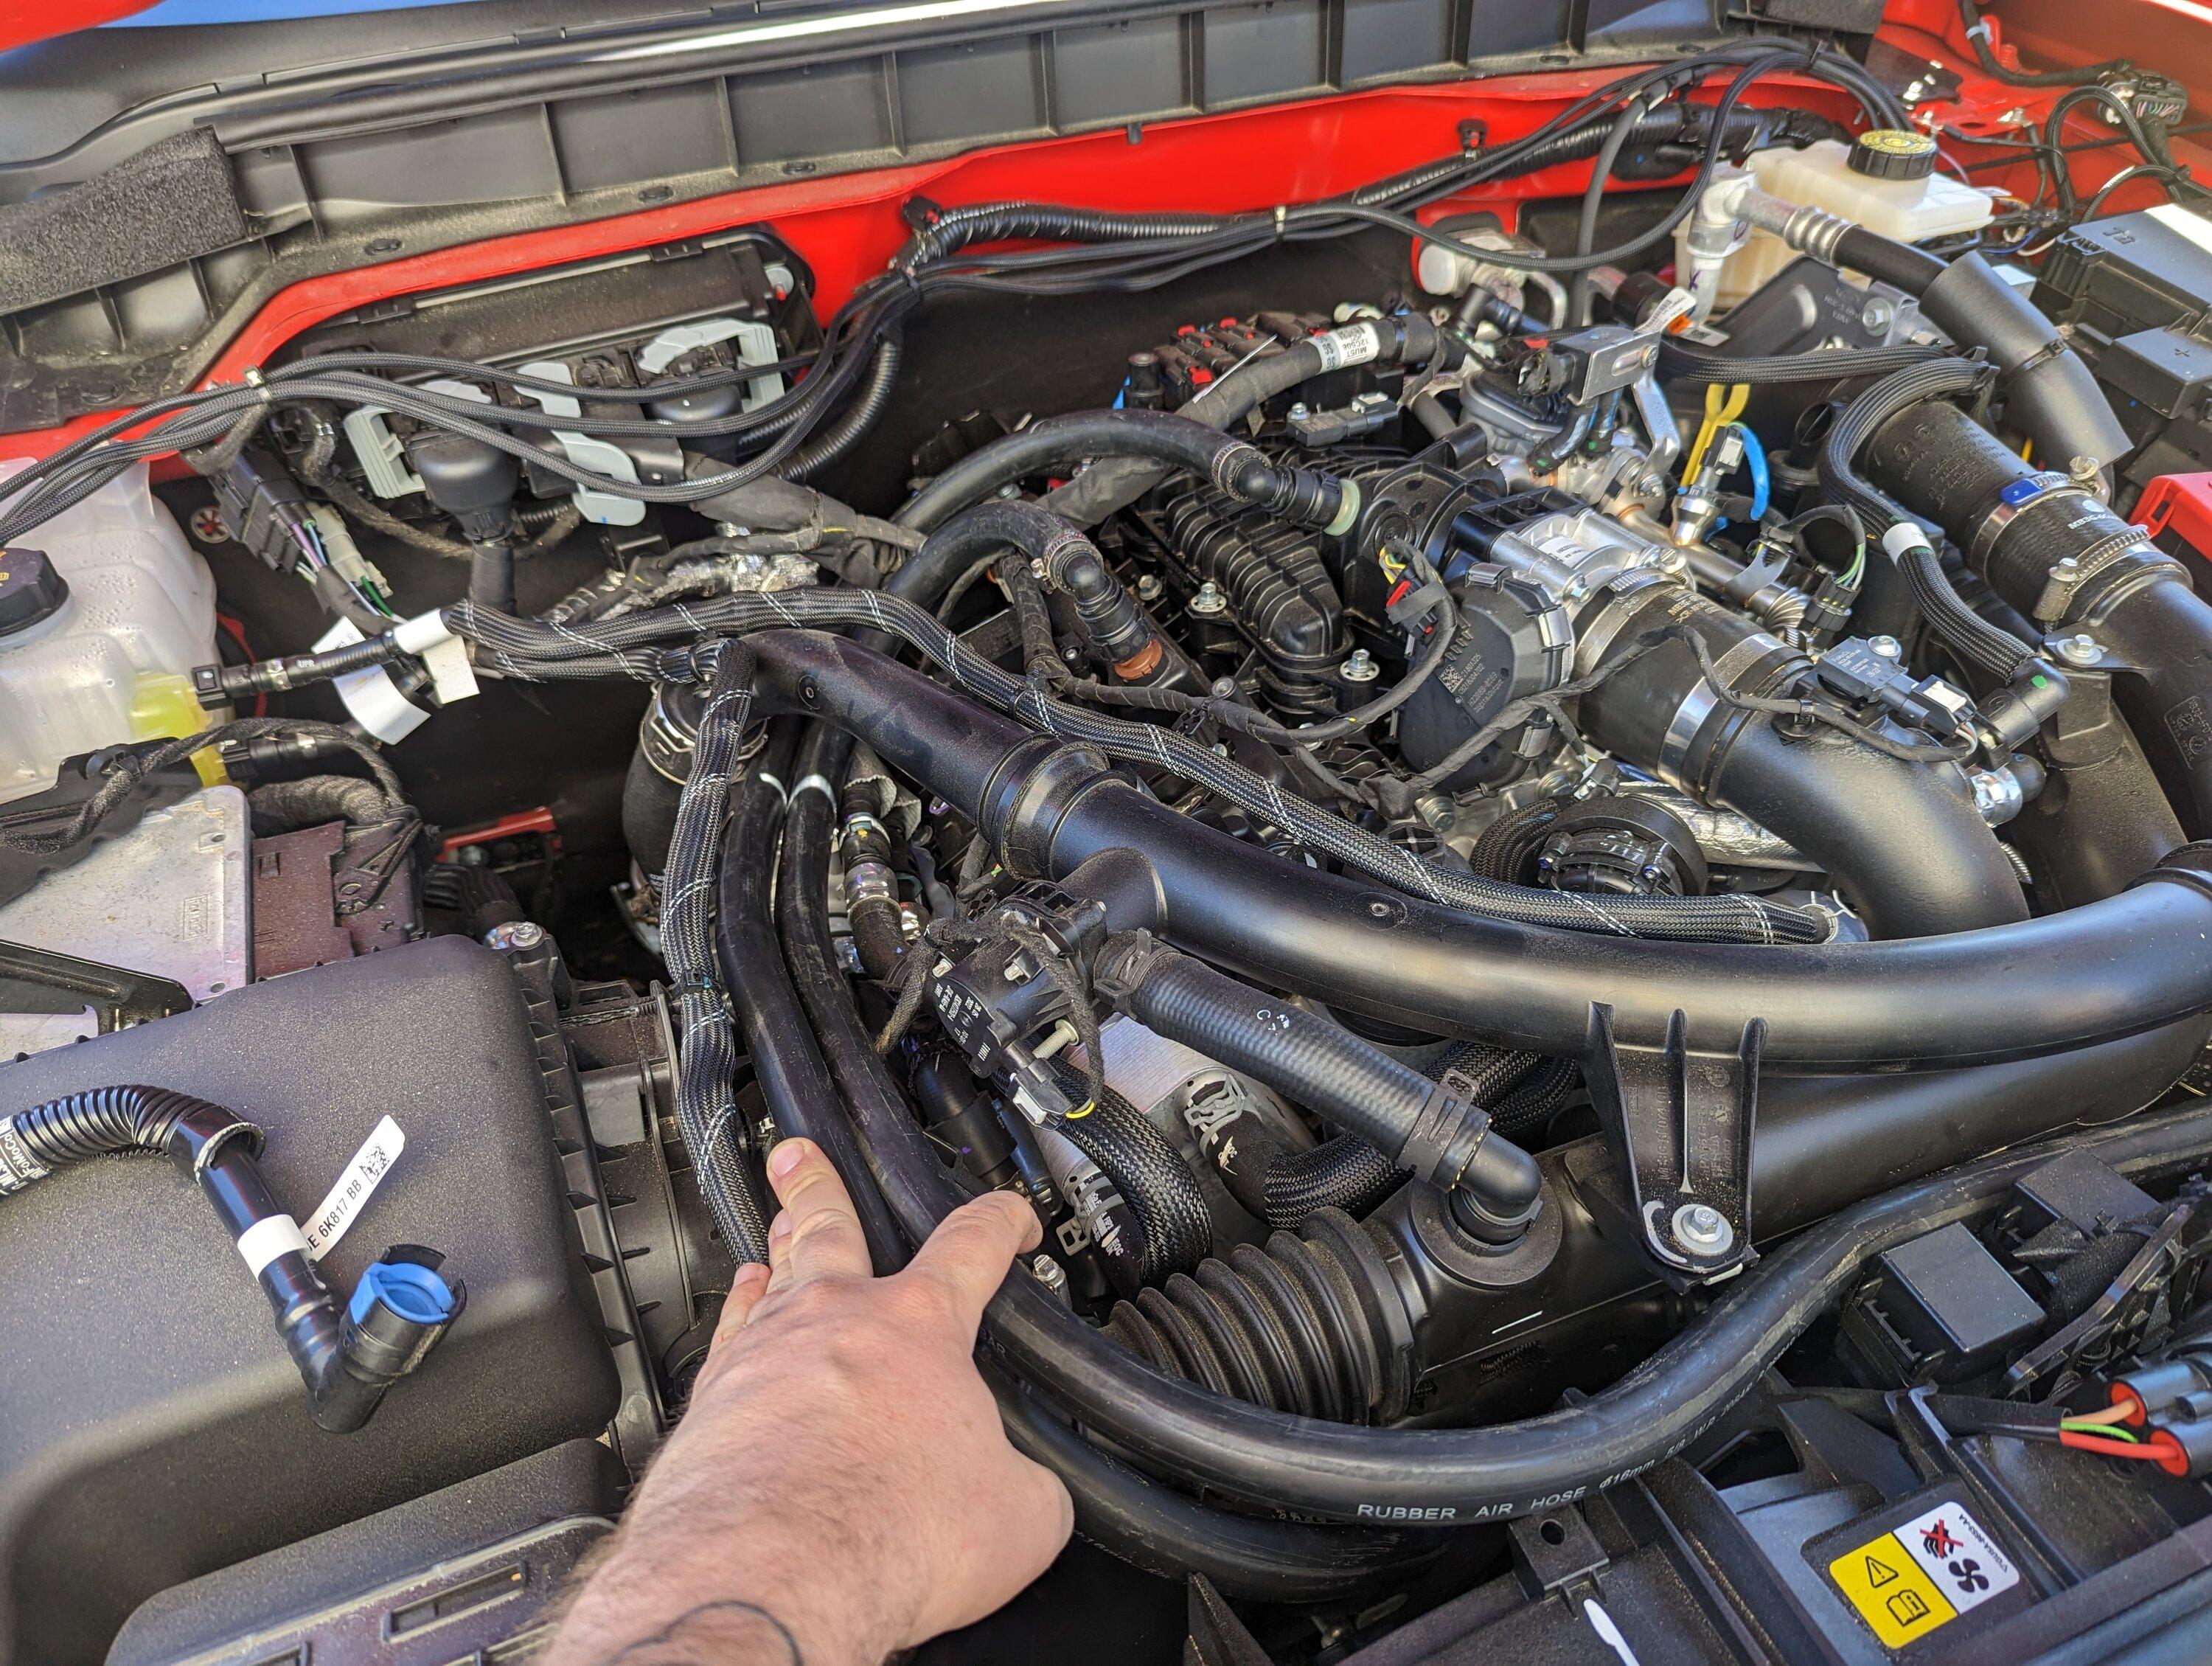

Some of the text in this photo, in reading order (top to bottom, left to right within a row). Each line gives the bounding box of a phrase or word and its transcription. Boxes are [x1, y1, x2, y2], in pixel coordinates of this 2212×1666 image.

[3, 1134, 32, 1173] FoMoCo
[318, 1198, 349, 1238] 6K817
[346, 1179, 362, 1199] BB
[1357, 1503, 1455, 1521] RUBBER
[1475, 1501, 1513, 1519] AIR
[1531, 1485, 1586, 1510] HOSE
